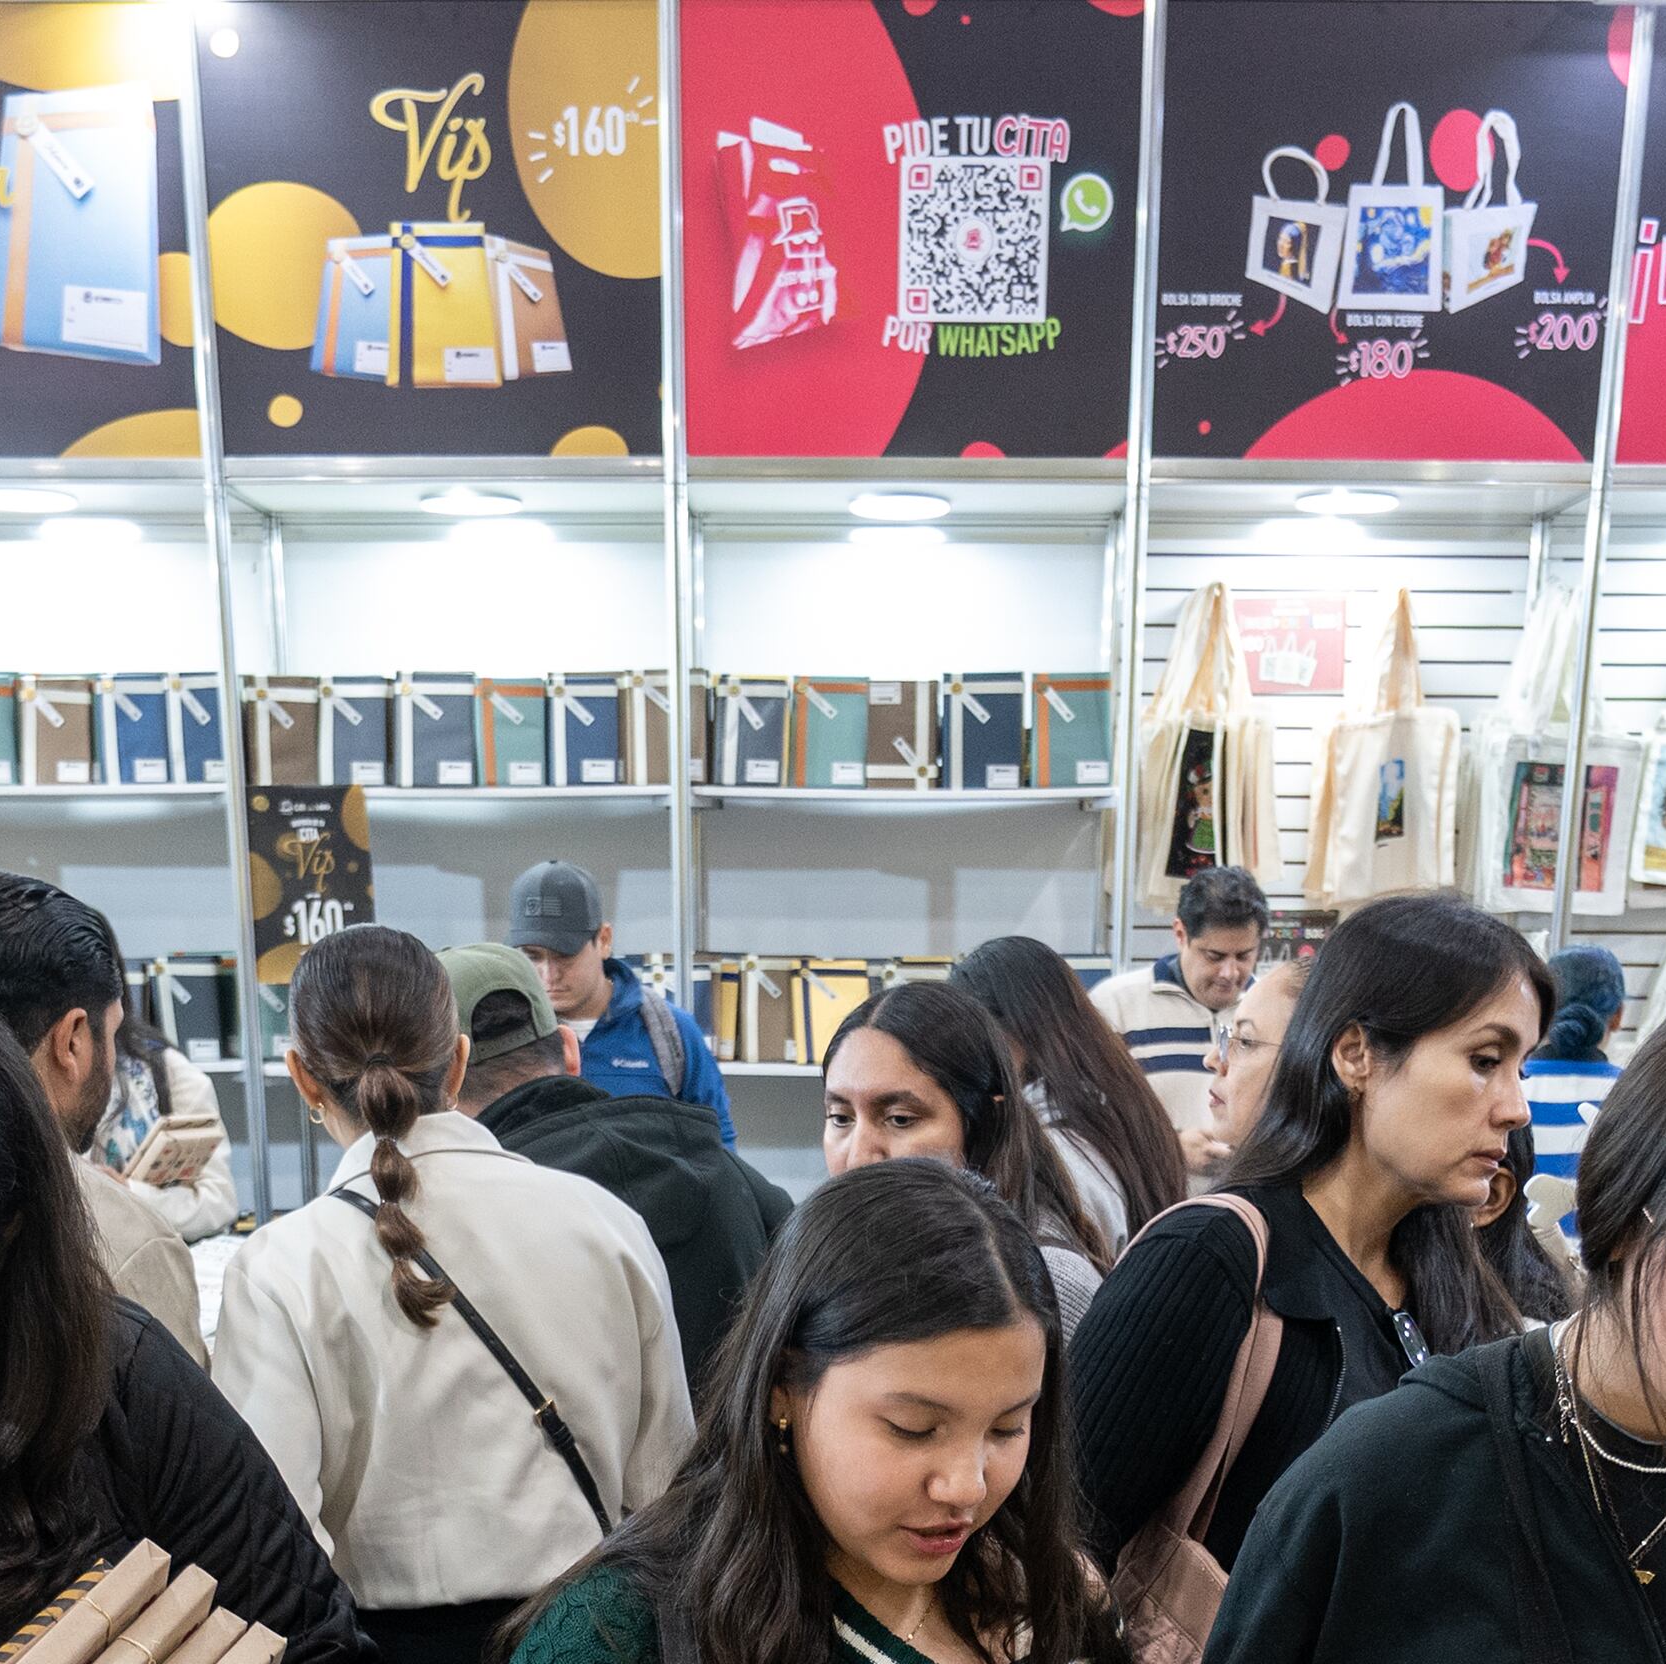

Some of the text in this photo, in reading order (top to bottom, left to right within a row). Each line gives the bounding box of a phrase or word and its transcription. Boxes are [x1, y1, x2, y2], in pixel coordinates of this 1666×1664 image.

[553, 105, 628, 157] $160
[882, 118, 949, 164] PIDE
[955, 116, 992, 157] TU
[882, 315, 1062, 358] POR WHATSAPP
[1166, 325, 1226, 359] $250
[1529, 312, 1599, 352] $200
[1348, 339, 1414, 379] $180
[283, 898, 345, 947] $160
